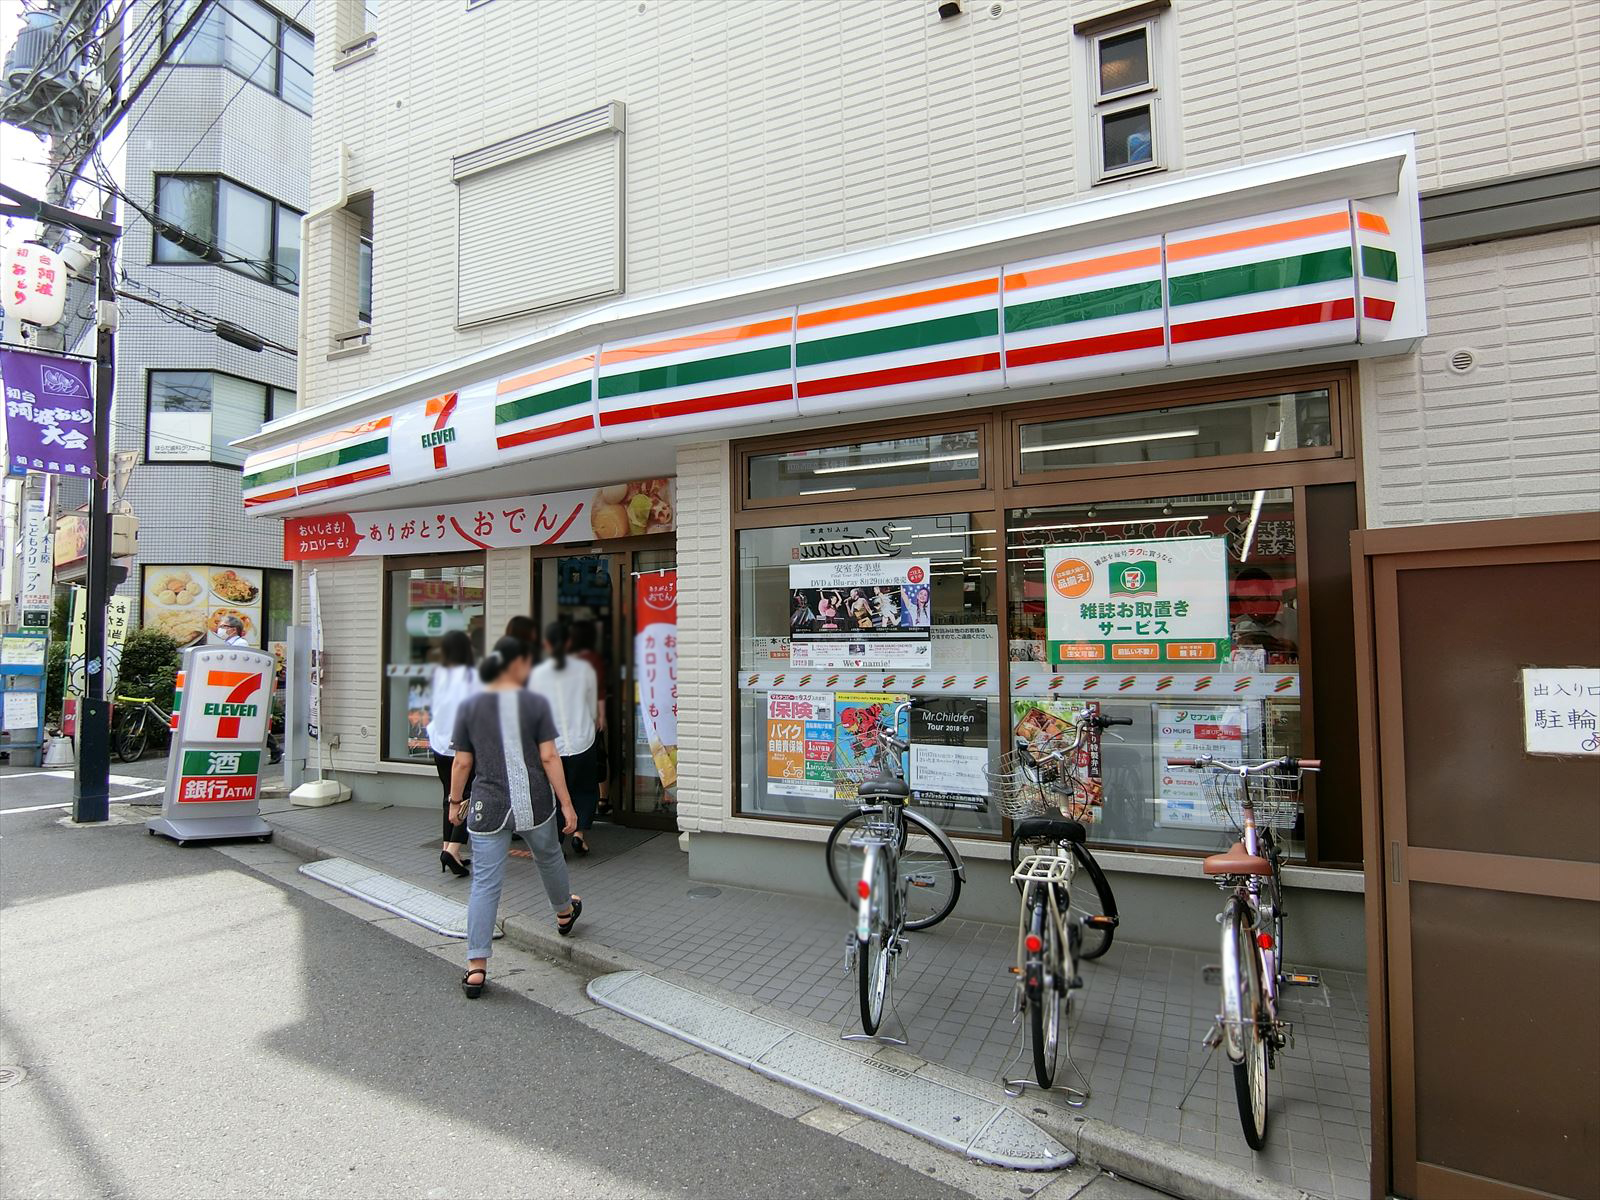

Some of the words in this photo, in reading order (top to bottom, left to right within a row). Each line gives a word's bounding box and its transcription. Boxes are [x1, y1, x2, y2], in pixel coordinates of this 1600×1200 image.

[6, 386, 36, 404] 初台
[6, 401, 93, 426] 阿波おどり
[40, 424, 89, 450] 大会
[473, 503, 559, 537] おでん
[369, 522, 446, 542] ありがとう
[27, 518, 39, 592] こどもクリニック
[811, 579, 827, 587] DVD
[833, 578, 858, 587] Blu-ray
[1080, 600, 1190, 620] 雑誌お取置き
[1098, 620, 1170, 636] サービス
[770, 701, 813, 719] 保険
[922, 711, 975, 723] Mr.Children
[1534, 708, 1597, 731] 駐輪
[771, 723, 802, 740] バイク
[927, 722, 944, 731] Tour
[206, 752, 242, 775] 酒
[184, 779, 253, 799] 銀行ATM
